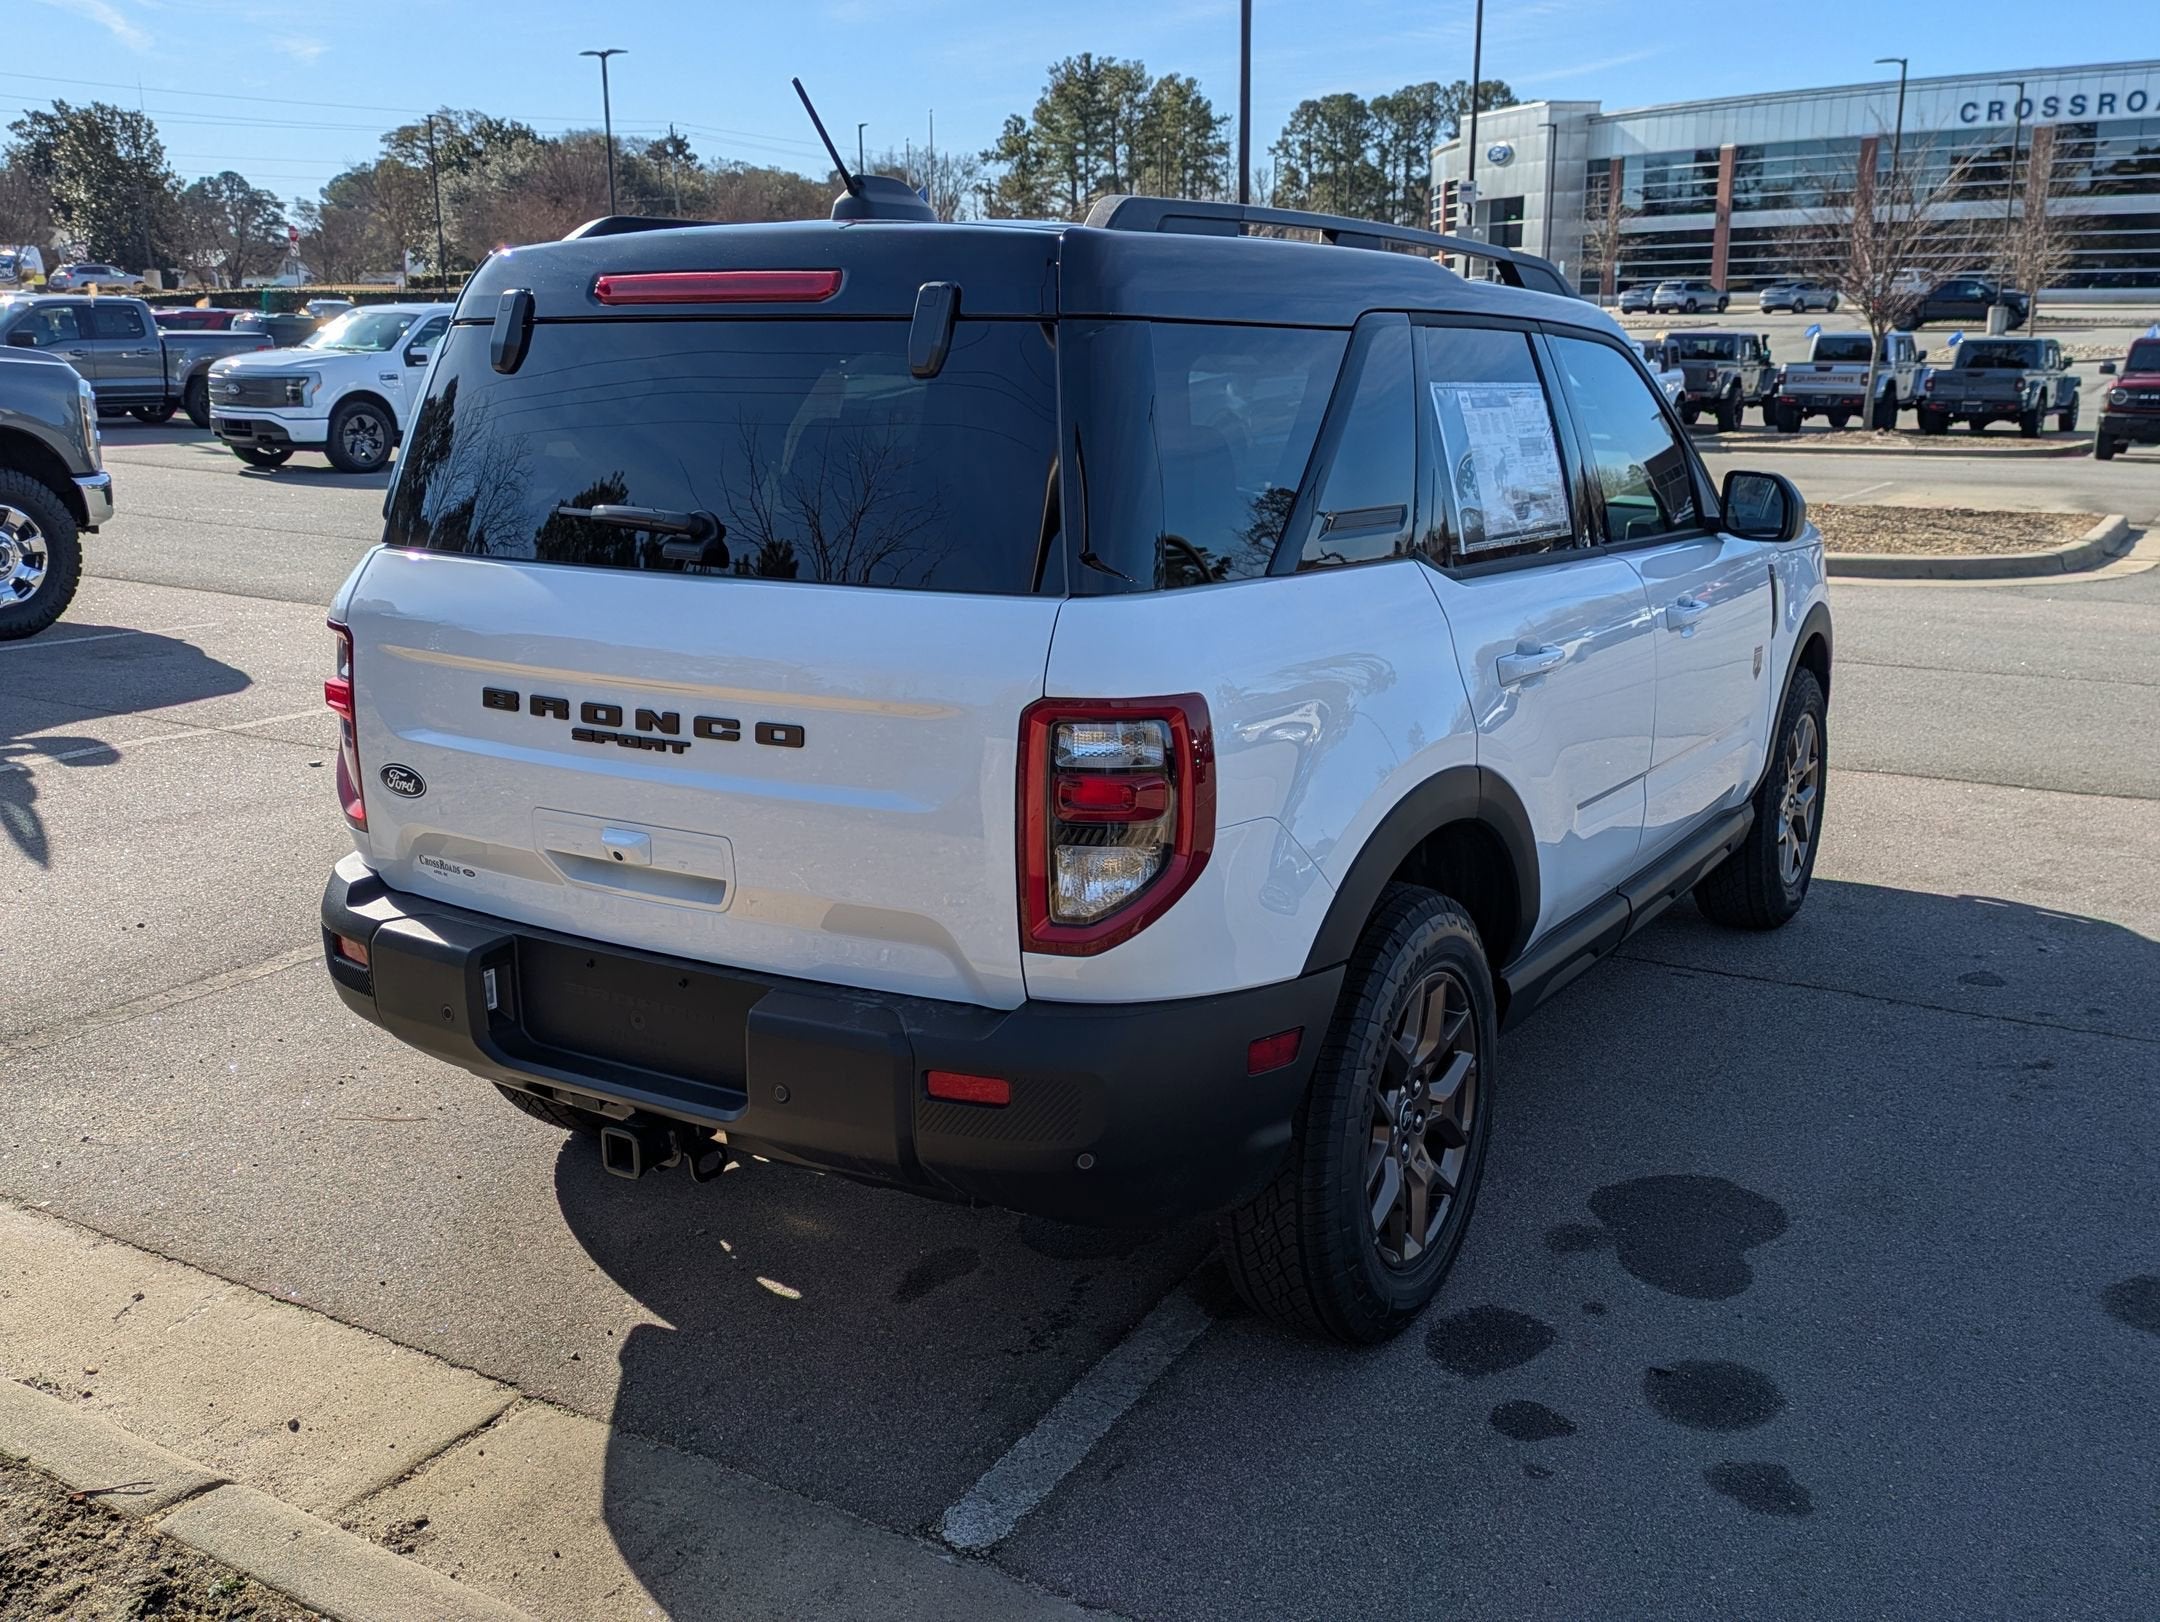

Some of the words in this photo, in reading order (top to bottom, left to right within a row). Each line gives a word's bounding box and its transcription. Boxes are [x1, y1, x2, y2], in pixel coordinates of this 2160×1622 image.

[1960, 90, 2160, 123] CROSSRO
[483, 687, 804, 748] BRONCO
[571, 728, 691, 754] SPORT
[387, 769, 415, 792] Ford
